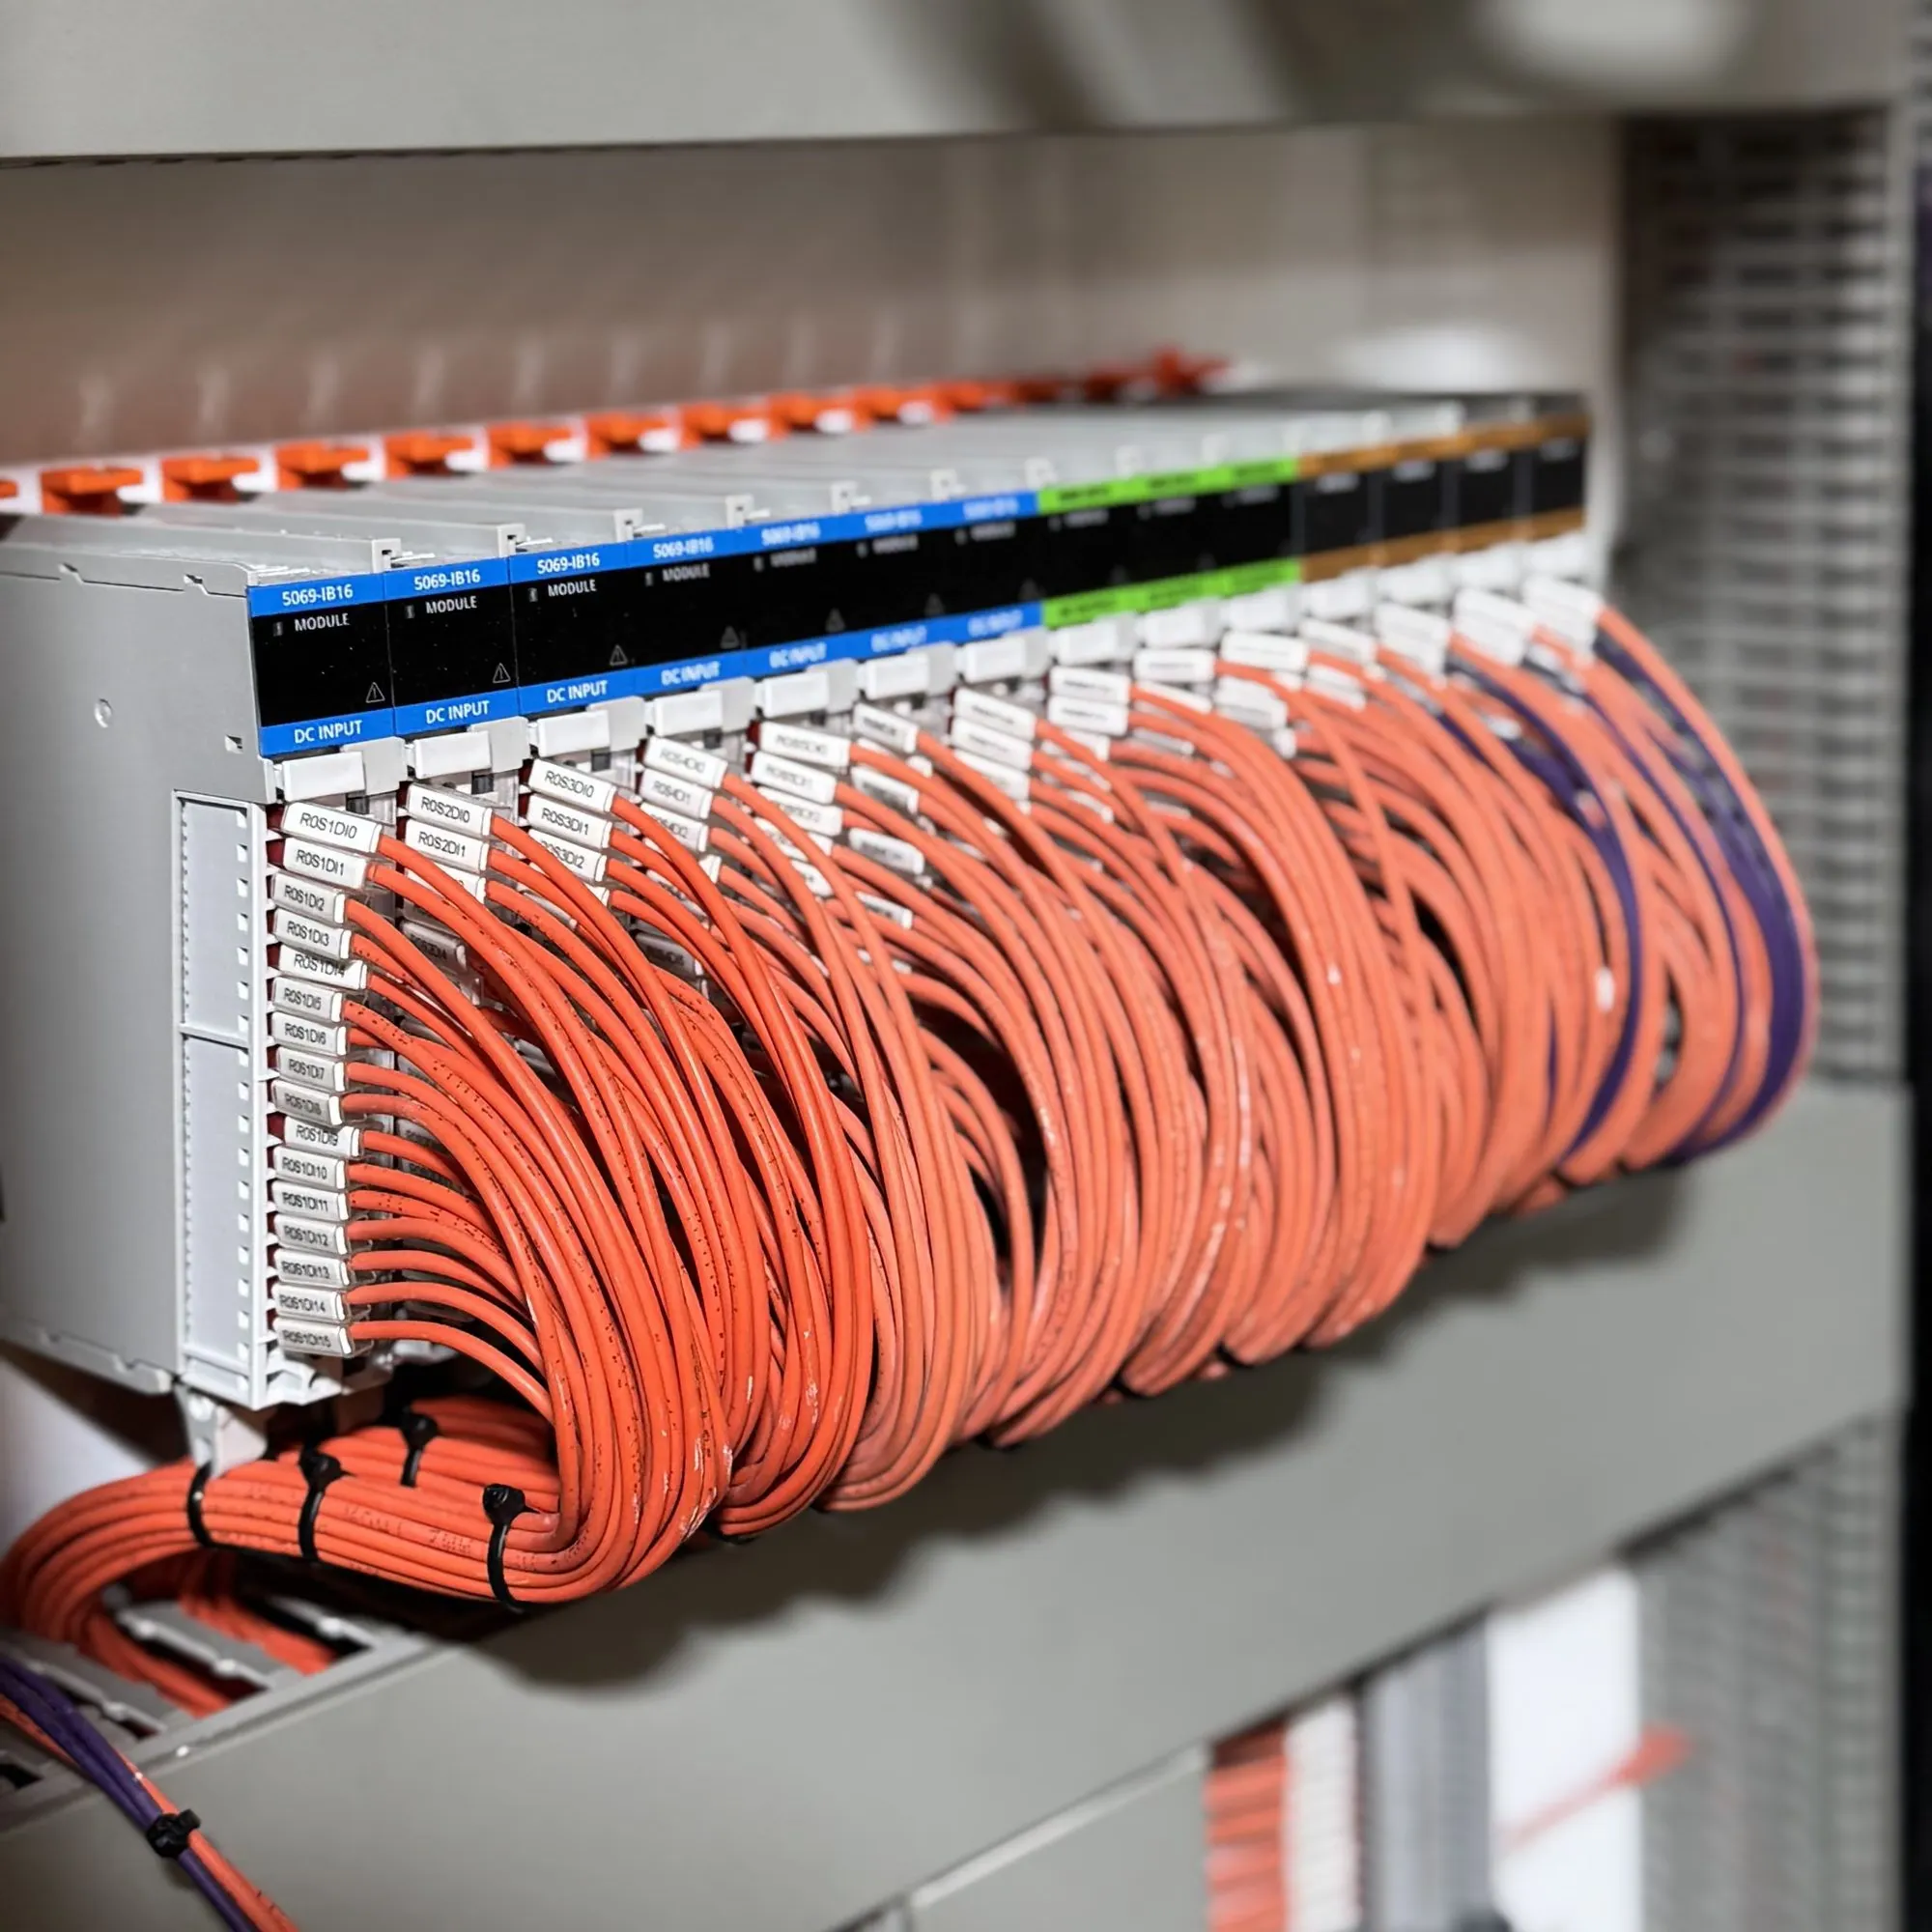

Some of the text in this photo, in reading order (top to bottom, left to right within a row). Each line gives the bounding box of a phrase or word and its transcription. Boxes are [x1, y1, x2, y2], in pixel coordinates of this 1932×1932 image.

[653, 536, 714, 558] 5069-IB16
[537, 553, 600, 574] 5069-IB16
[662, 562, 710, 582] MODULE
[413, 569, 481, 591] 5069-IB16
[548, 580, 597, 597] MODULE
[282, 583, 354, 607] 5069-IB16
[426, 595, 477, 614] MODULE
[294, 612, 351, 632] MODULE
[661, 661, 720, 686] DC INPUT
[547, 680, 608, 703] DC INPUT
[426, 700, 490, 724] DC INPUT
[294, 720, 363, 744] DC INPUT
[545, 771, 594, 798] R0S3DI0
[421, 796, 470, 823] R0S2DI0
[300, 812, 357, 838] R0S1DI0
[541, 809, 588, 836] R0S3DI1
[418, 831, 466, 858] R0S2DI1
[297, 850, 344, 875] R0S1DI1
[284, 885, 325, 911] R0S1DI2
[287, 922, 329, 947] R0S1DI3
[284, 987, 322, 1010] R0S1DI5
[285, 1023, 327, 1044] R0S1DI6
[288, 1059, 325, 1079] R0S1DI7
[282, 1157, 327, 1179] R0S1DI10
[282, 1192, 328, 1209] R0S1DI11
[284, 1225, 328, 1246] R0S1DI12
